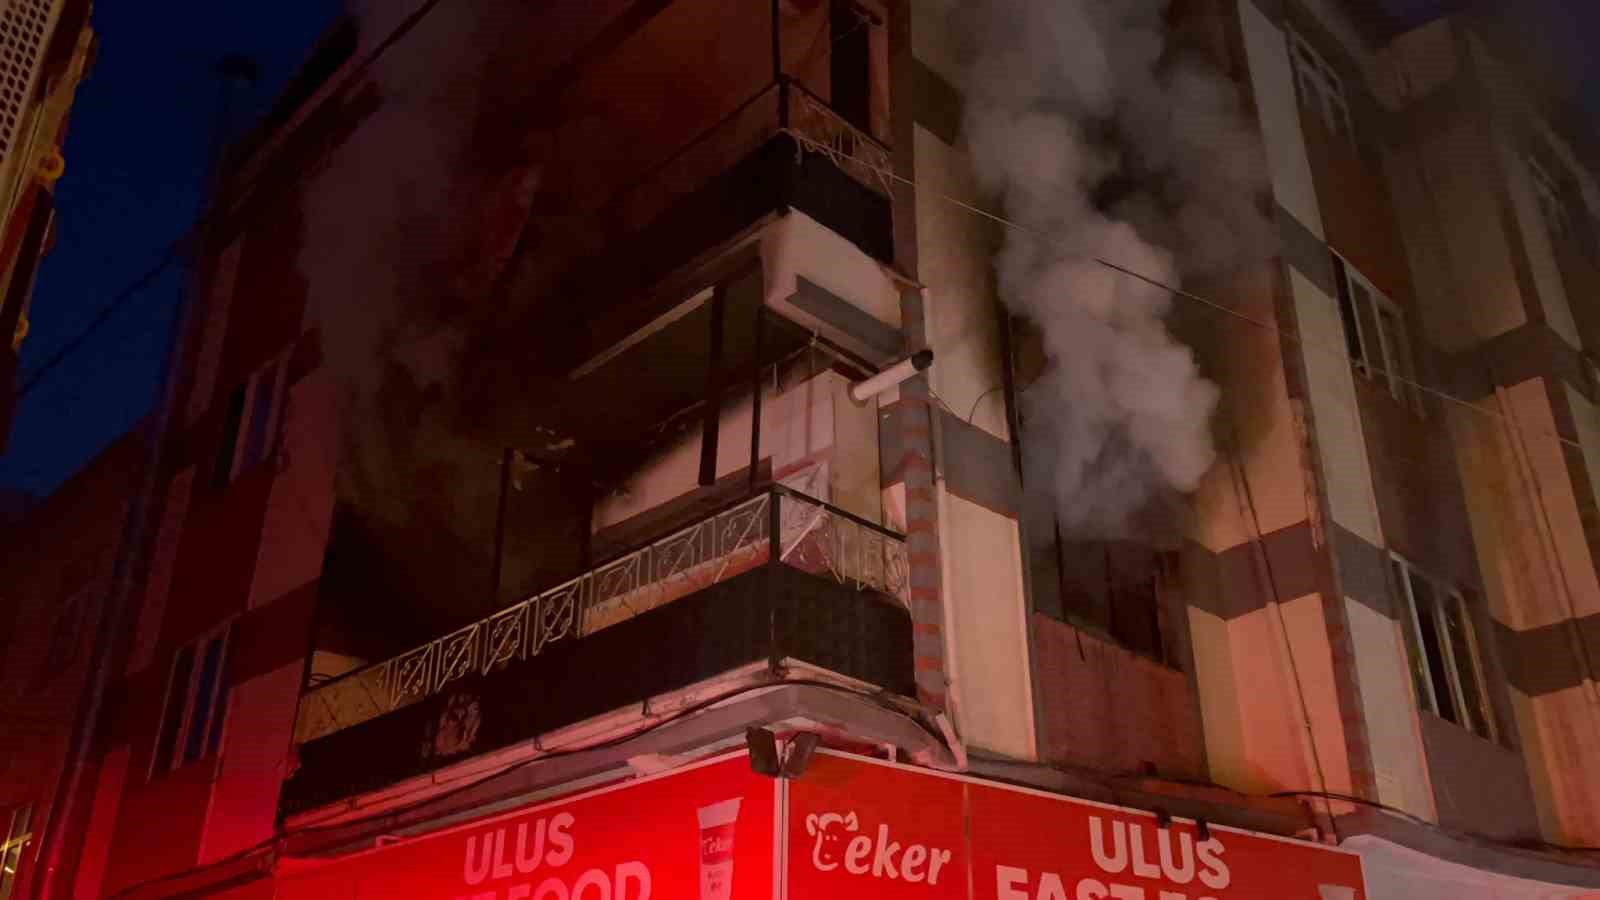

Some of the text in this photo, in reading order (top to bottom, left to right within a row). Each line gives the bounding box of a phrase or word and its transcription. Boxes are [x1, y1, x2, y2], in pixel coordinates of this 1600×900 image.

[464, 812, 575, 885] ULUS
[1089, 816, 1230, 889] ULUS
[508, 861, 652, 900] OD
[996, 865, 1146, 900] FA
